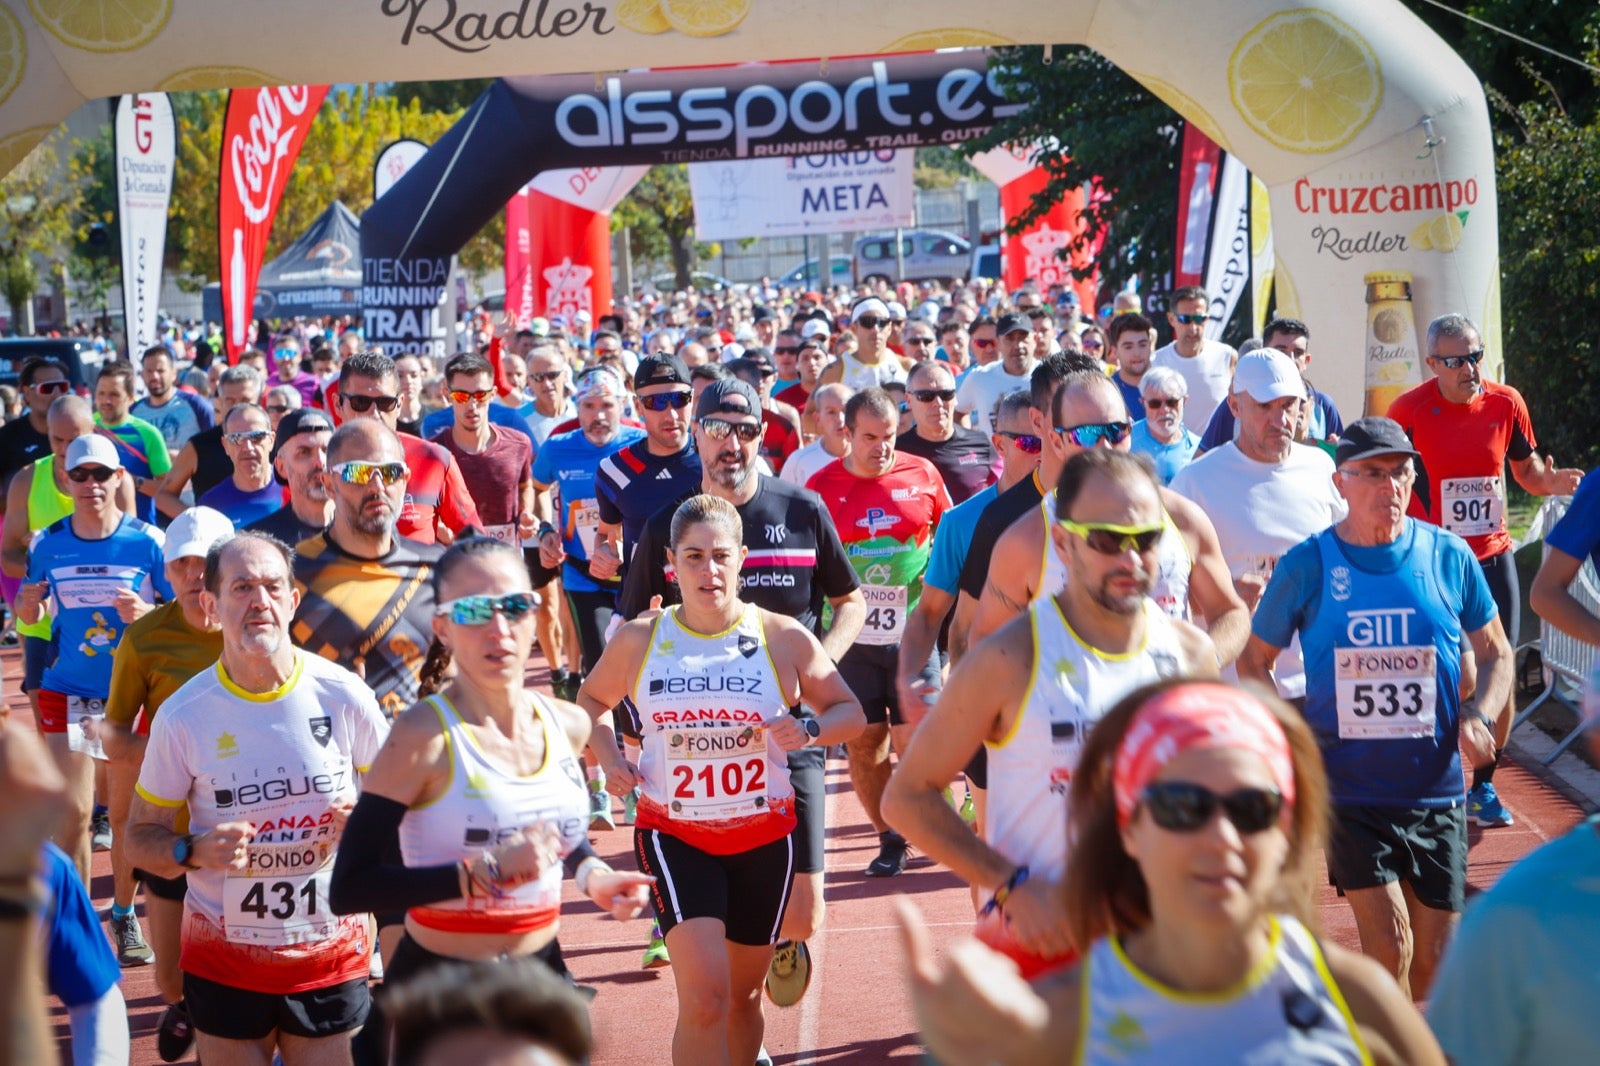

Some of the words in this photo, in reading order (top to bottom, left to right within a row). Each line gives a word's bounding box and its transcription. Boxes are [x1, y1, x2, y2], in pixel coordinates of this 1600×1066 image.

[381, 0, 615, 53] Radler
[661, 147, 731, 162] TIENDA
[754, 139, 848, 157] RUNNING
[865, 132, 923, 148] TRAIL
[801, 183, 889, 213] META
[1294, 176, 1478, 214] Cruzcampo
[1311, 225, 1409, 261] Radler
[364, 259, 447, 283] TIENDA
[364, 286, 447, 306] RUNNING
[364, 308, 447, 338] TRAIL
[365, 341, 446, 358] TDOOR
[1457, 482, 1493, 493] FONDO
[1452, 499, 1491, 522] 901
[862, 590, 896, 600] ONDO
[1358, 656, 1418, 671] FONDO
[1353, 683, 1423, 717] 533
[652, 709, 764, 724] GRANADA
[688, 735, 749, 751] FONDO
[673, 758, 766, 799] 2102
[249, 849, 315, 868] FONDO
[240, 878, 317, 920] 431
